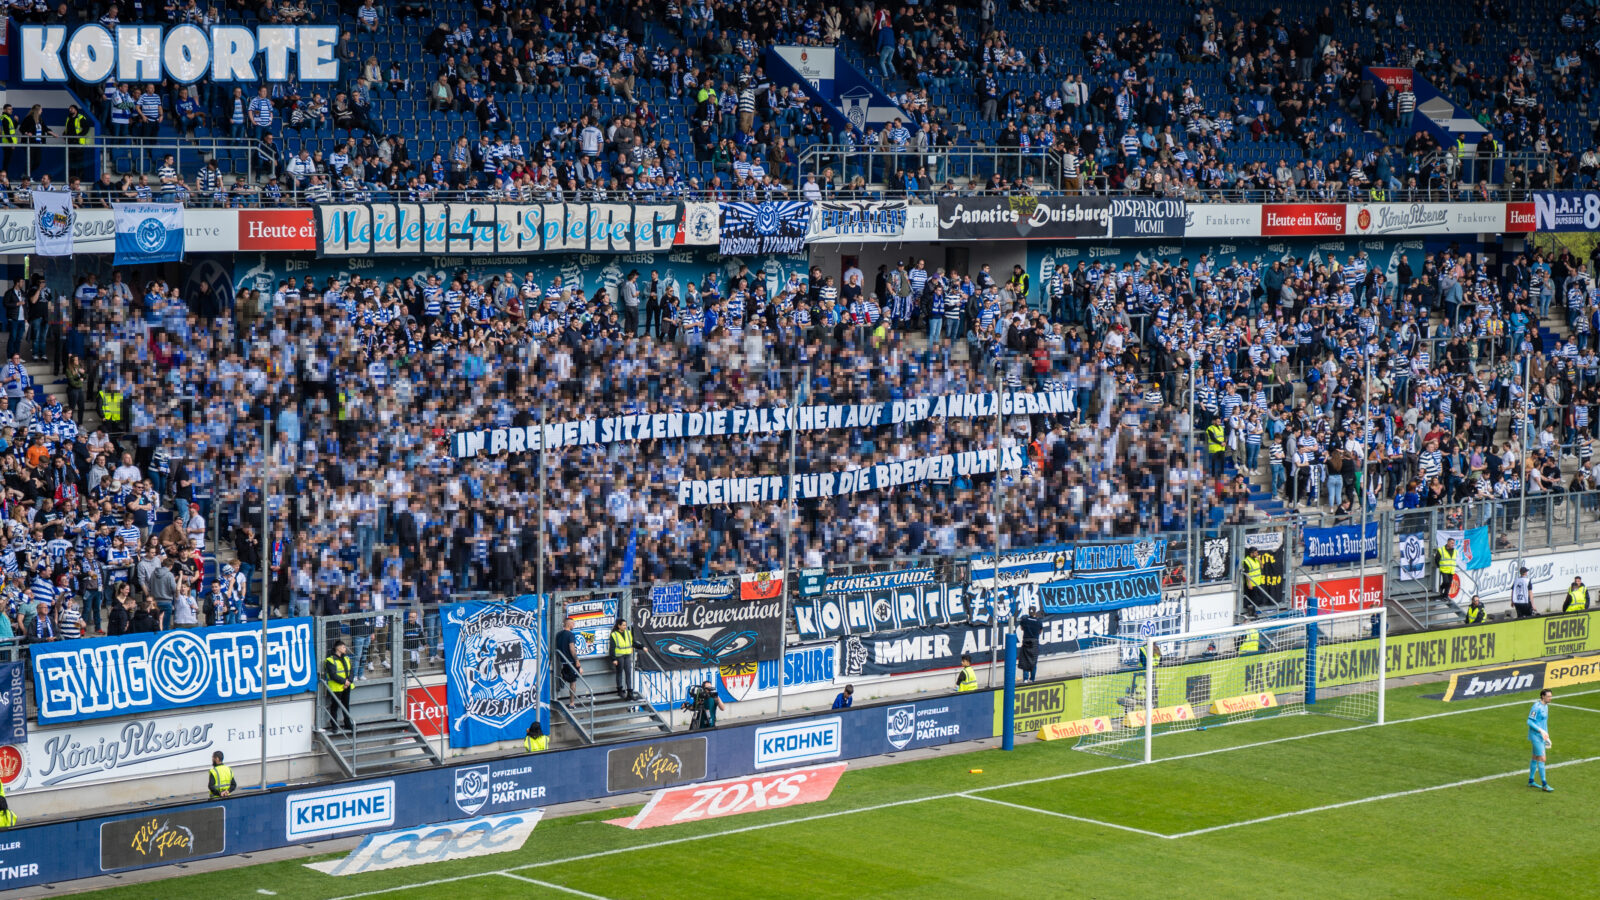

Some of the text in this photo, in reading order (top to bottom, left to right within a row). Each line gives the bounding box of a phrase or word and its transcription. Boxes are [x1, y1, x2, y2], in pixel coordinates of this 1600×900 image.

[940, 202, 1109, 229] Fanatics Duisburg
[1112, 199, 1186, 218] DISPARGUM
[1377, 203, 1448, 230] König Pilsener
[1457, 211, 1497, 223] Fankurve
[1510, 210, 1535, 224] Heute
[0, 213, 37, 245] Köni
[324, 208, 512, 244] Meidericher
[520, 209, 676, 250] Spielverein
[912, 215, 938, 229] Fank
[1134, 219, 1165, 234] MCMII
[1205, 213, 1251, 226] Fankurve
[1266, 209, 1342, 230] Heute ein König
[1555, 216, 1584, 225] DUISBURG
[248, 220, 316, 239] Heute ei
[286, 258, 309, 273] DIETZ
[470, 256, 528, 266] WEDAUSTADION
[457, 390, 1076, 458] IN BREMEN SITZEN DIE FALSCHEN AUF DER ANKLAGEBANK
[679, 445, 1023, 506] FREIHEIT FÜR DIE BREMER ULTRAS
[1074, 539, 1167, 571] METROPOL 47
[1468, 559, 1554, 594] König Pilener
[1559, 564, 1599, 577] Fankurve
[653, 584, 682, 595] SEKTION
[1041, 574, 1160, 607] WEDAUSTADION
[1295, 593, 1328, 611] Hete
[1329, 592, 1348, 607] ein
[573, 616, 614, 629] NKSRHEIN
[637, 600, 781, 629] Proud Generation
[1547, 618, 1586, 641] CLARK
[874, 634, 952, 665] IMMER
[1318, 643, 1402, 683] ZUSAMMEN
[1405, 638, 1447, 670] EINEN
[1450, 632, 1496, 664] HEBEN
[1546, 642, 1586, 655] THE FORKLIFT
[36, 623, 312, 719] EWIG TREU
[758, 646, 834, 690] DUSBURG
[1464, 661, 1600, 696] bwin SPORT
[11, 667, 25, 738] DUISBURG
[916, 706, 949, 717] OFFIZIELLER
[1222, 697, 1257, 713] Sinalco
[916, 720, 938, 731] 1902-
[1013, 720, 1023, 732] HE
[1136, 710, 1173, 726] Snalco
[916, 724, 960, 741] PARTNER
[1051, 721, 1090, 739] Sinalco
[40, 733, 122, 777] König
[118, 720, 214, 760] Pilsener
[763, 729, 834, 755] KROHNE
[492, 766, 533, 778] OFFIZIELLER
[632, 746, 679, 782] Flic Flac
[491, 780, 519, 794] 1902-
[491, 786, 546, 805] PARTNER
[672, 773, 807, 822] ZOXS
[297, 795, 385, 826] KROHNE
[0, 841, 21, 851] LLER
[131, 817, 190, 857] Flic Flac
